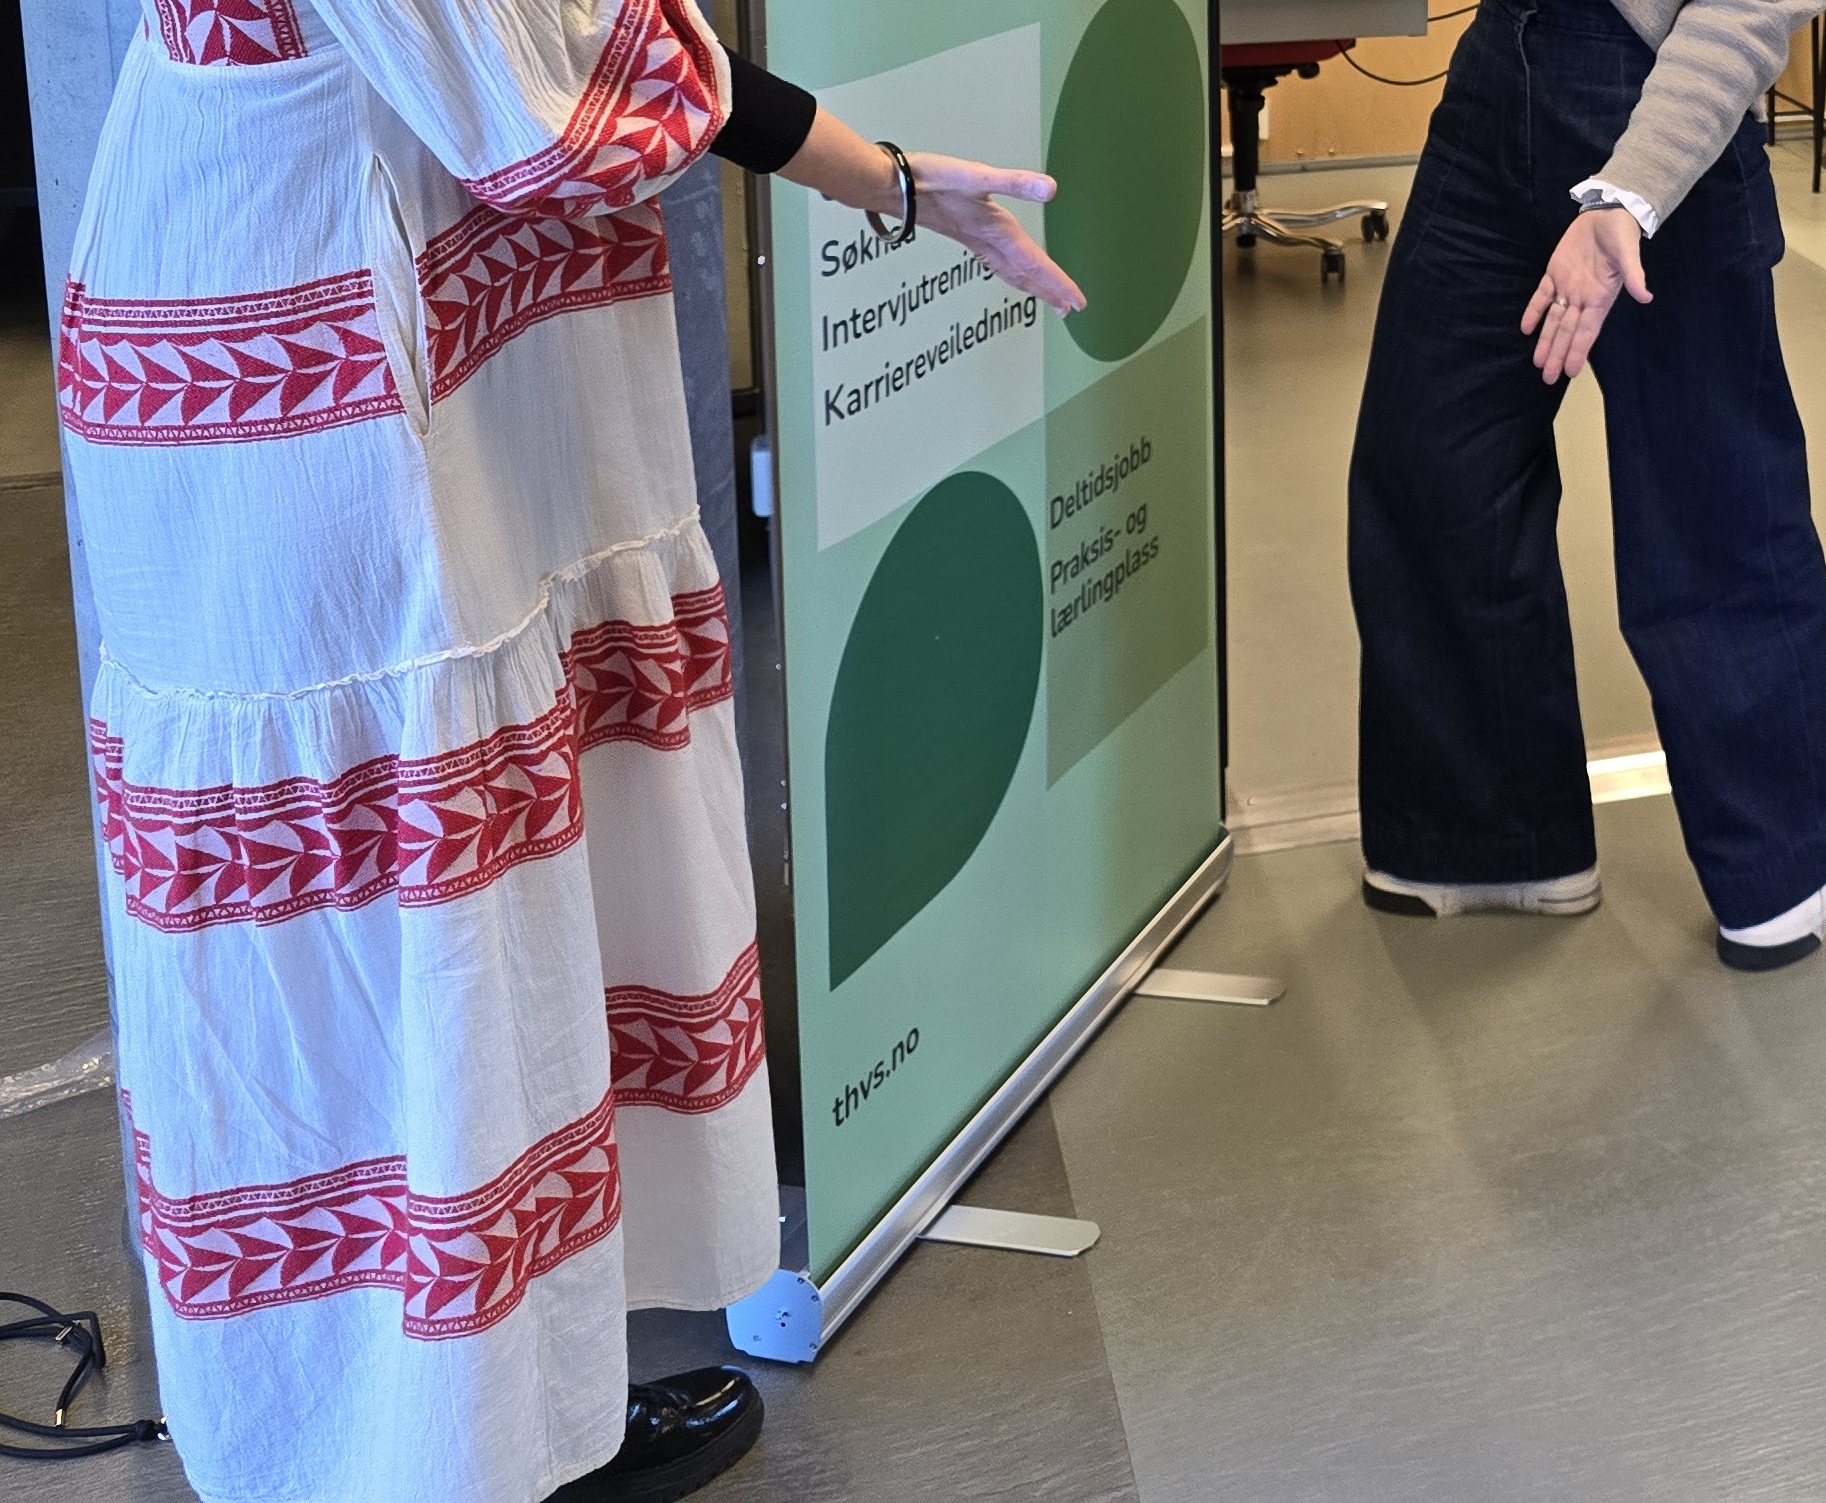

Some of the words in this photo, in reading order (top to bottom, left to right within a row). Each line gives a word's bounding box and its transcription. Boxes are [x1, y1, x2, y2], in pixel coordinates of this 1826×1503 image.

[824, 296, 1037, 426] Karriereveiledning
[1050, 435, 1152, 530] Deltidsjobb
[1050, 525, 1122, 595] Praksis-
[1125, 502, 1148, 534] og
[1051, 535, 1159, 638] lærlingplass
[831, 1027, 920, 1128] thvs.no
